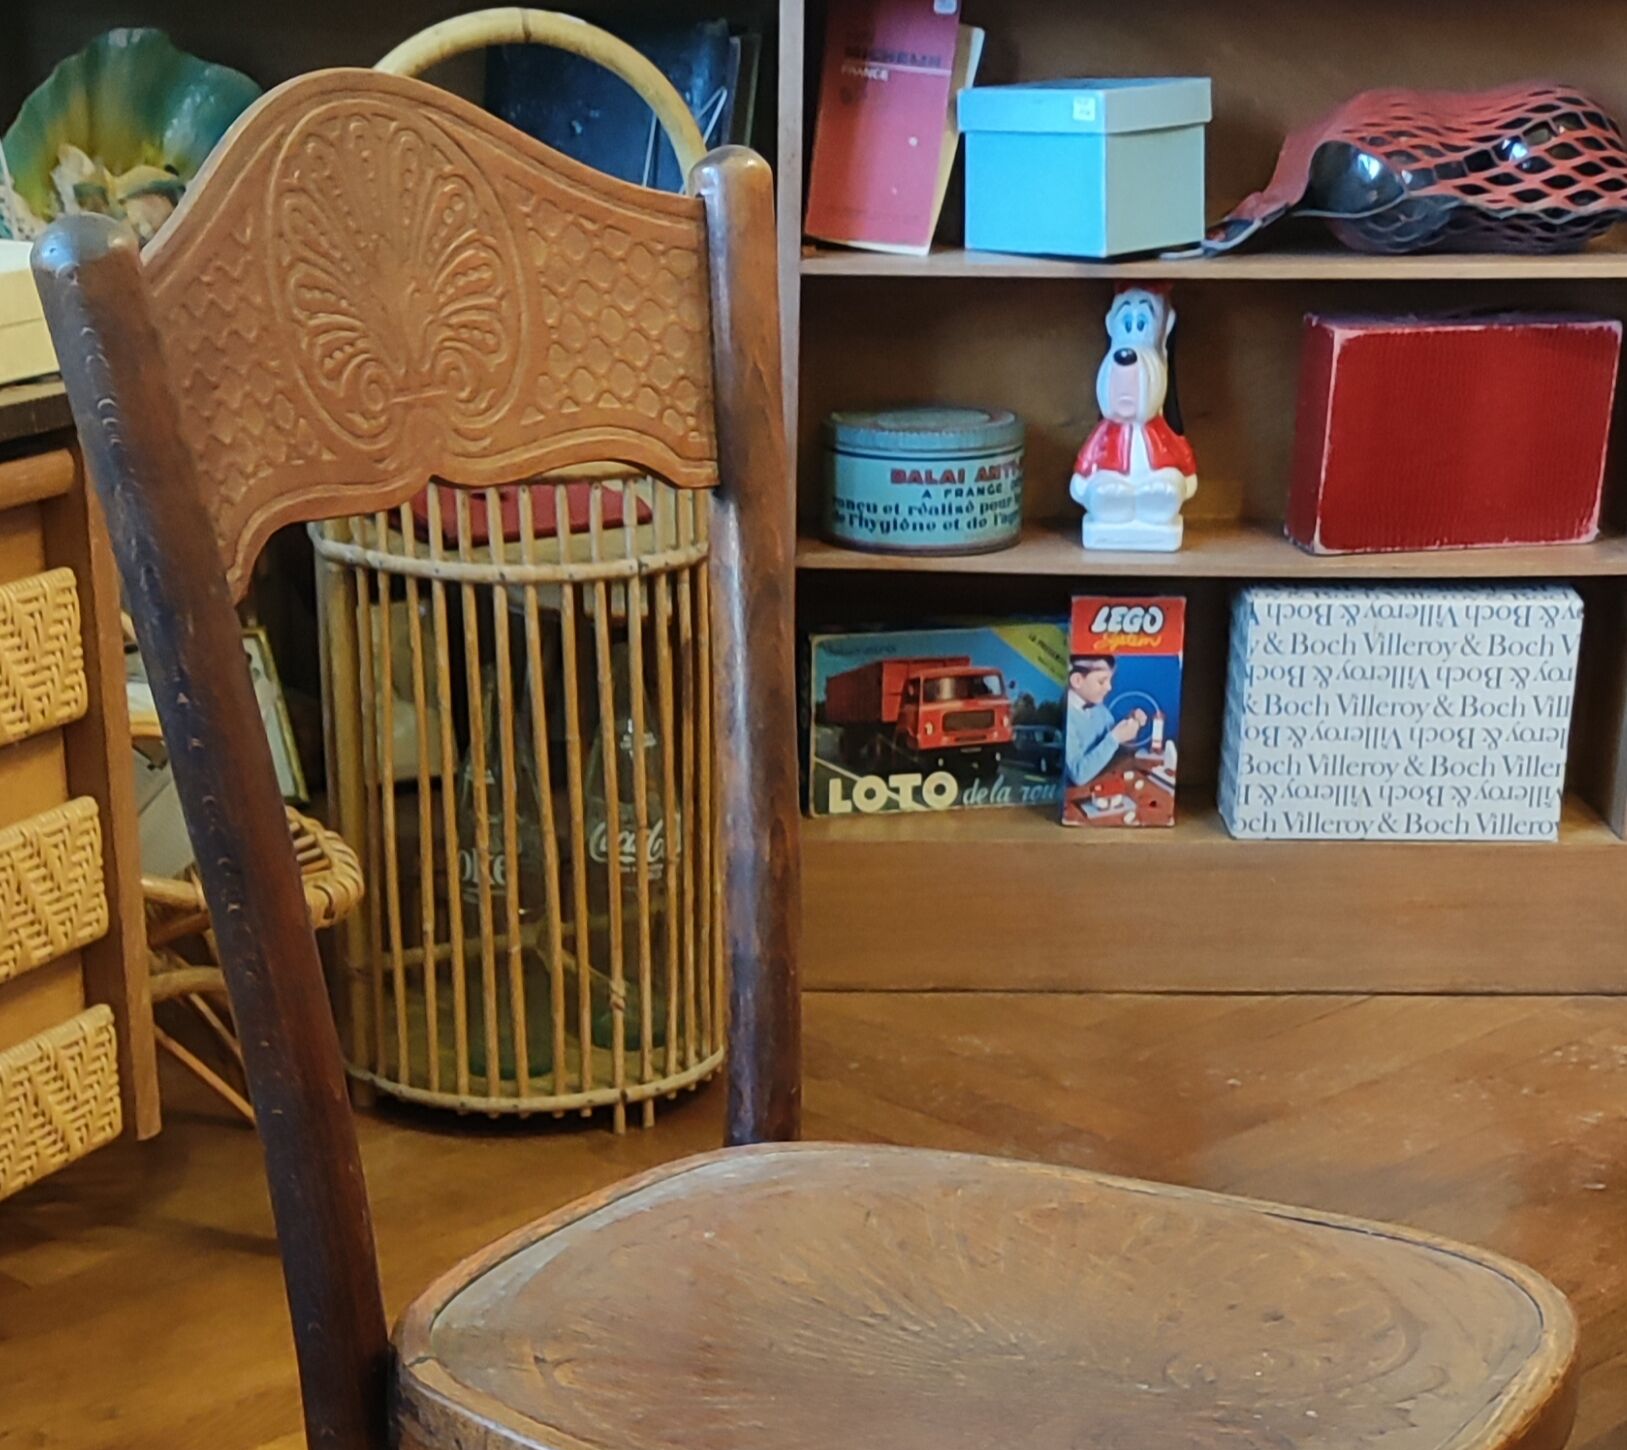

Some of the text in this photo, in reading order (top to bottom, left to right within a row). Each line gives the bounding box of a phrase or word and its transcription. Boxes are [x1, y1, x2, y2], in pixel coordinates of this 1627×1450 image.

[890, 467, 966, 485] BALAI
[921, 489, 932, 499] A
[882, 502, 899, 515] et
[943, 518, 960, 531] et
[966, 516, 987, 530] de
[1090, 605, 1165, 635] LEGO
[1262, 631, 1284, 655] &
[1290, 631, 1357, 656] Boch
[1363, 632, 1457, 662] Villeroy
[1459, 633, 1482, 657] &
[1488, 633, 1555, 658] Boch
[1263, 693, 1331, 717] Boch
[1336, 693, 1432, 723] Villeroy
[1432, 694, 1455, 718] &
[1460, 694, 1528, 719] Boch
[1307, 754, 1400, 781] Villeroy
[1402, 755, 1426, 779] &
[1430, 755, 1498, 779] Boch
[828, 771, 959, 813] LOTO
[963, 778, 987, 806] de
[989, 774, 1011, 804] la
[1281, 812, 1375, 838] Villeroy
[1376, 812, 1401, 836] &
[1404, 812, 1471, 836] Boch
